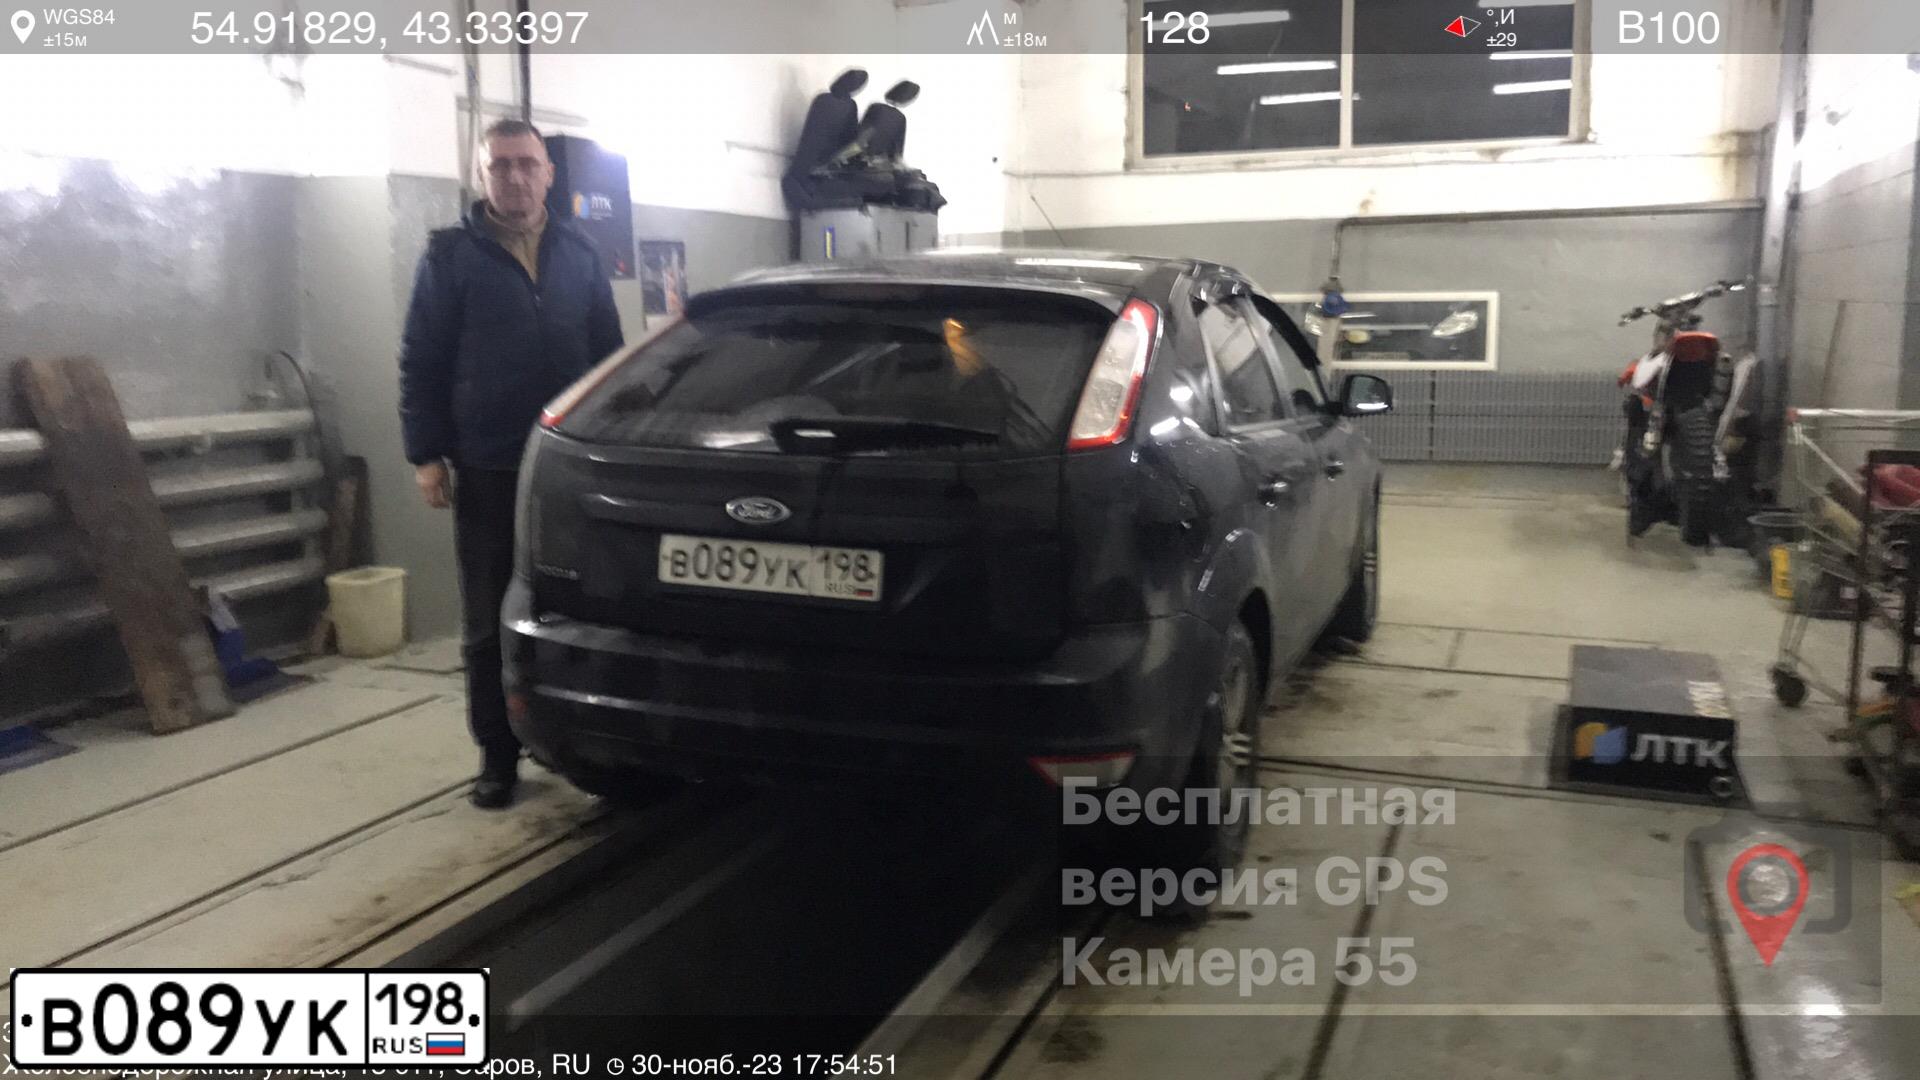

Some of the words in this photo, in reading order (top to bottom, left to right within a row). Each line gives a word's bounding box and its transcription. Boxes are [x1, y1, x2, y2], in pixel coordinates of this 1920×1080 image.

[670, 542, 807, 590] В089УК
[815, 551, 870, 582] 198
[1629, 732, 1731, 769] ЛТК
